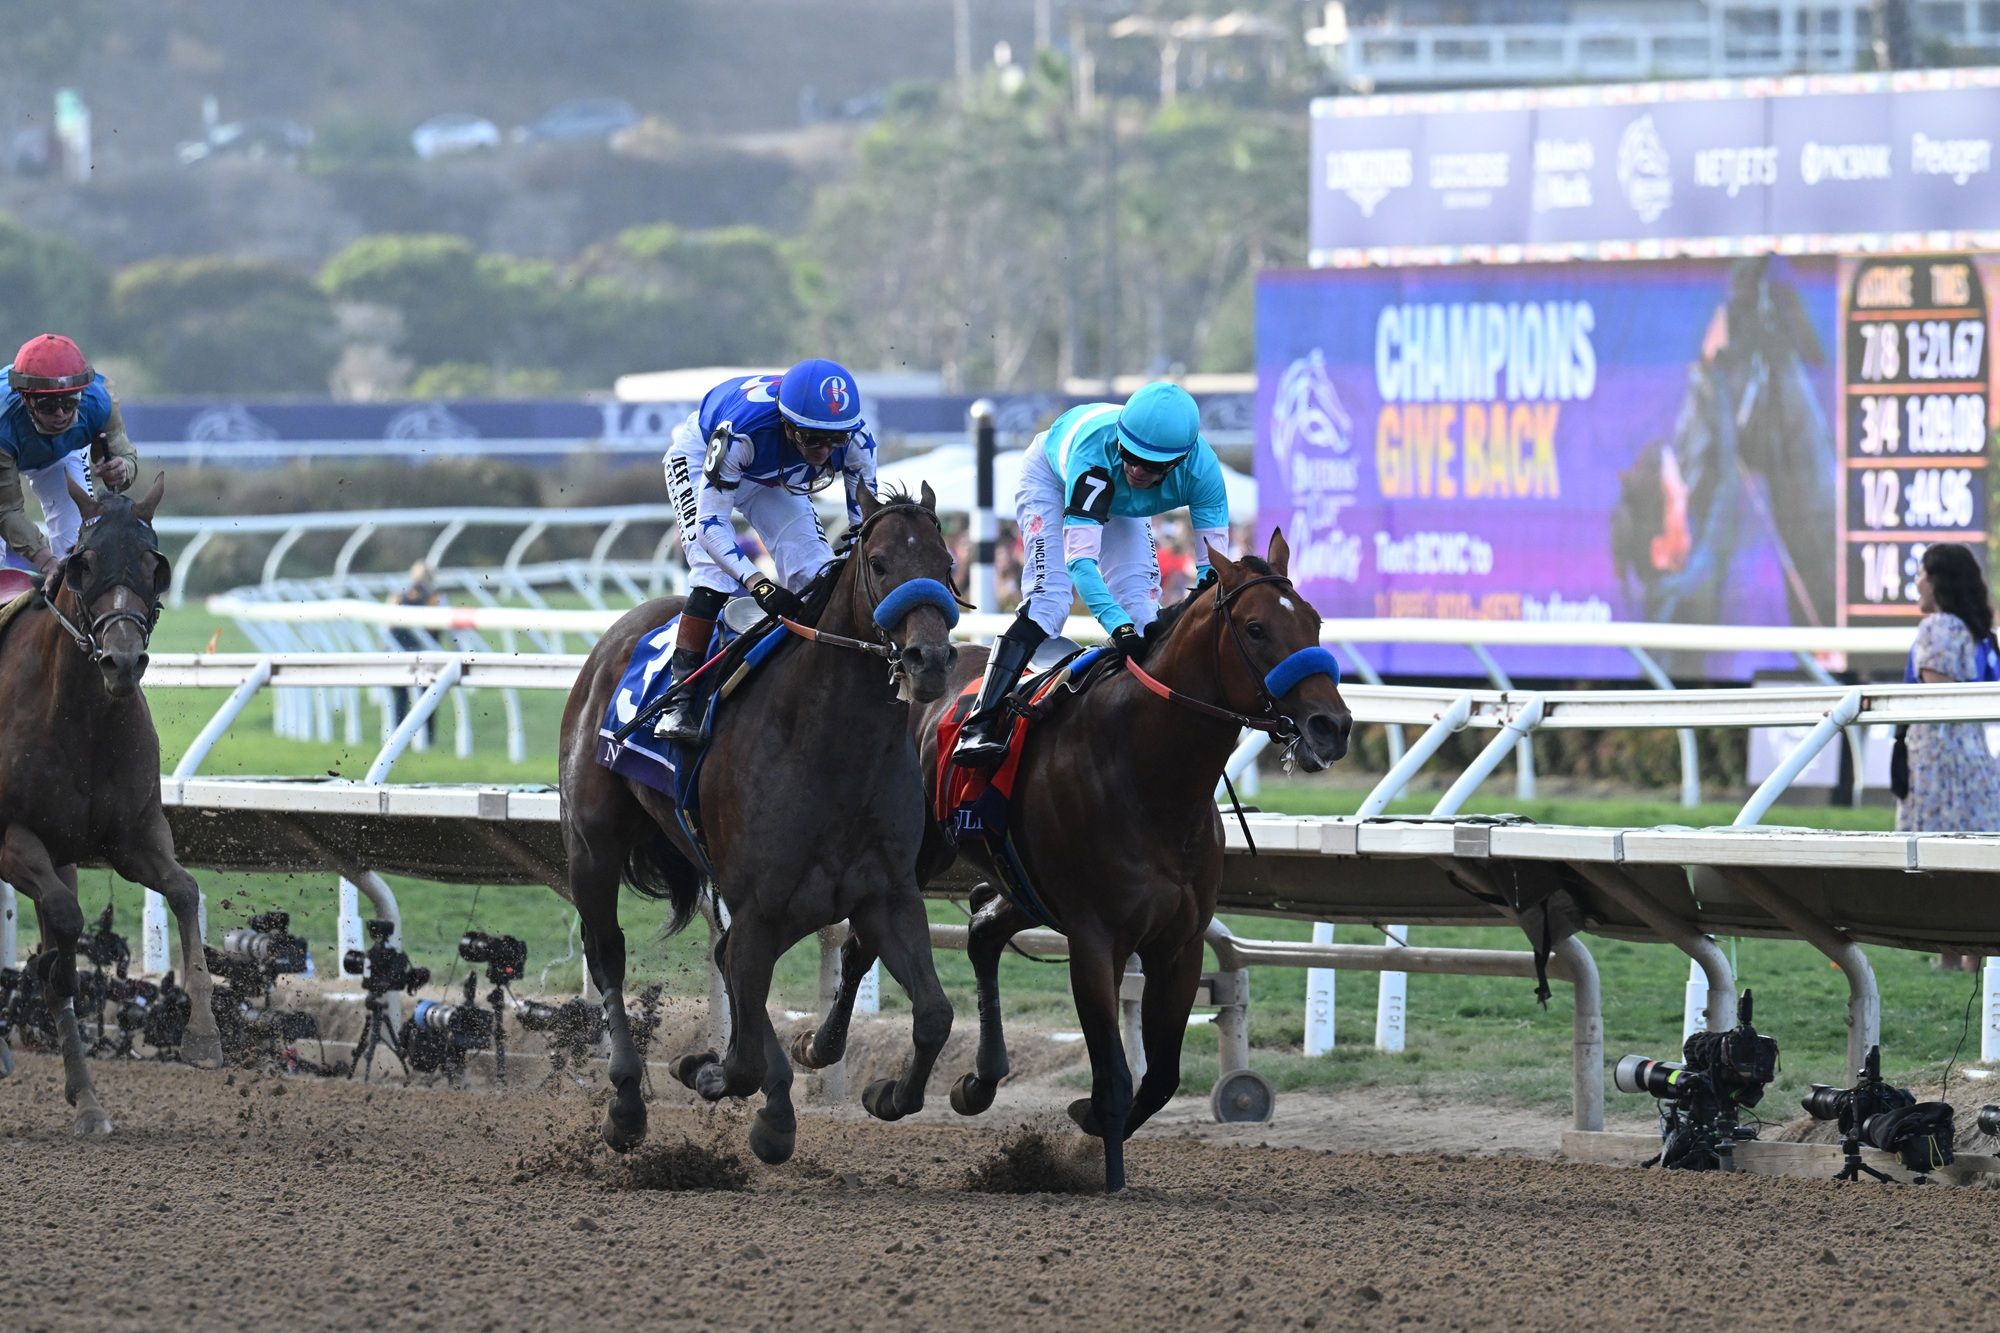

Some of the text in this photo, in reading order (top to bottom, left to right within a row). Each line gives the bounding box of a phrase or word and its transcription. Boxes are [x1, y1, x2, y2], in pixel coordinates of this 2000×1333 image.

[1375, 301, 1597, 400] CHAMPIONS
[671, 456, 690, 486] JEFF
[705, 438, 722, 472] 3
[1375, 402, 1561, 497] GIVE BACK
[1082, 475, 1107, 512] 7
[1034, 538, 1046, 571] UNCLE
[1861, 543, 1901, 602] 1/4
[616, 622, 680, 725] 3
